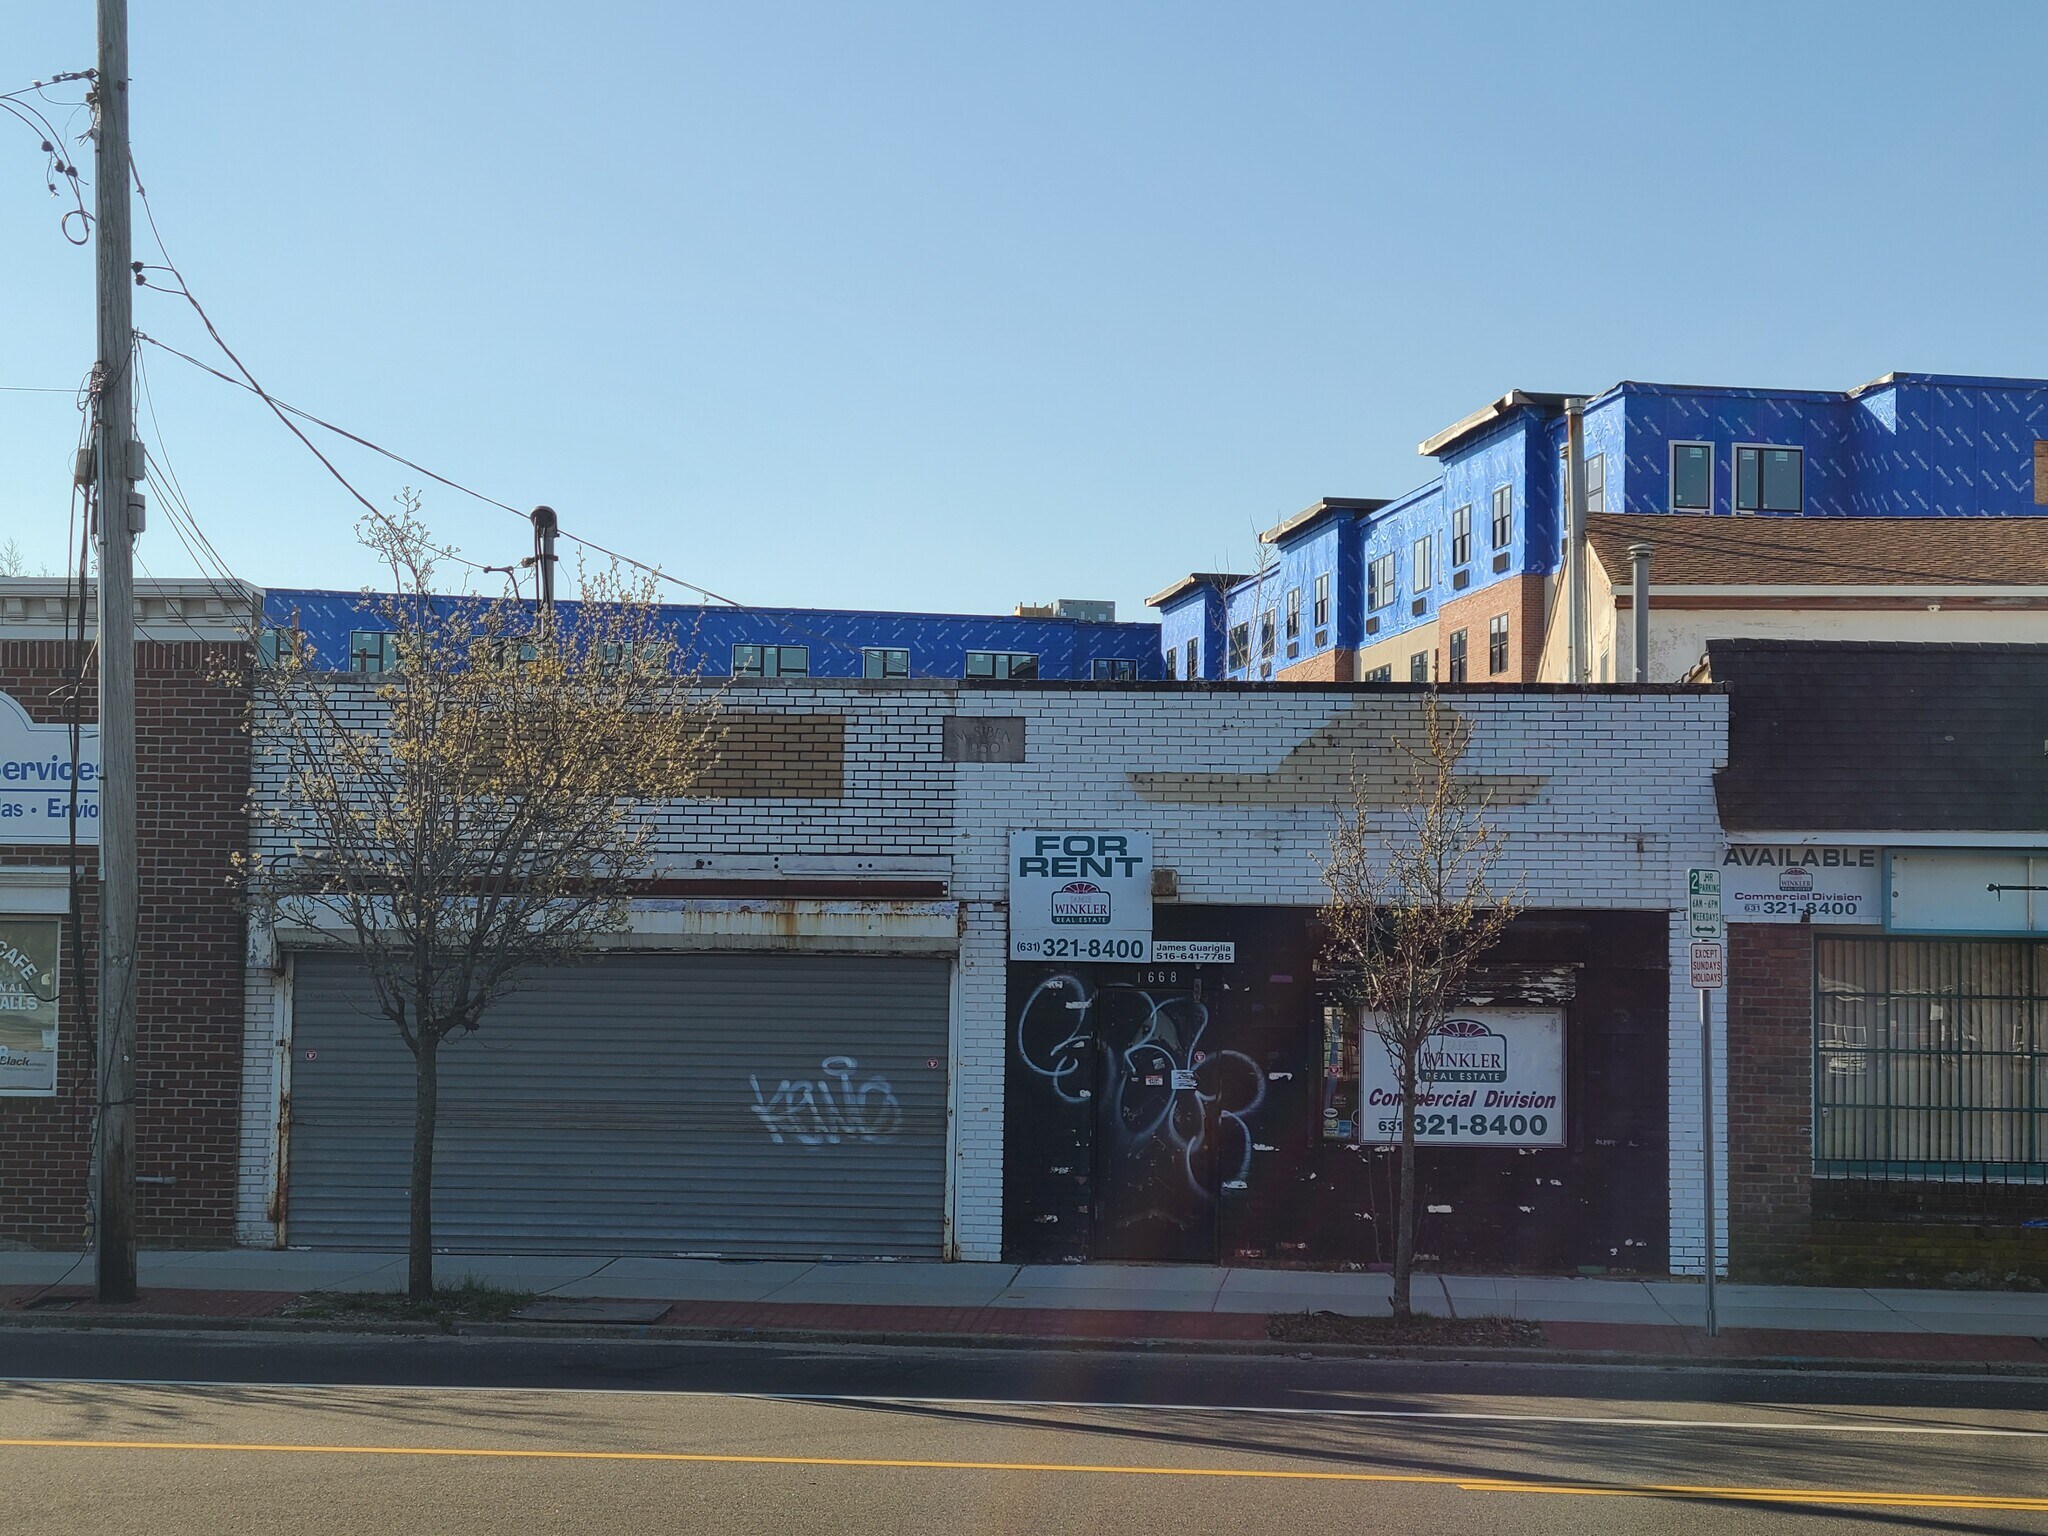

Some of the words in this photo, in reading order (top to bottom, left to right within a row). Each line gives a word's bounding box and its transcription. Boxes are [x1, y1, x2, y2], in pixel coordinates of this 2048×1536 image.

[0, 754, 98, 780] ervice
[0, 798, 23, 817] as
[1035, 835, 1128, 856] FOR
[1722, 849, 1875, 867] AVAILABLE
[1019, 856, 1143, 878] RENT
[1691, 872, 1699, 890] 2
[1700, 884, 1720, 892] PARKING
[1734, 891, 1810, 901] Commercial
[1812, 892, 1862, 901] Division
[1054, 903, 1108, 915] WINKLER
[1763, 902, 1857, 915] 321-8400
[1693, 913, 1718, 921] WEEKDAYS
[1016, 941, 1041, 953] (631)
[1042, 938, 1143, 959] 321-8400
[1156, 943, 1187, 951] James
[1189, 943, 1231, 953] Guariglia
[1695, 949, 1717, 958] EXCEPT
[1156, 953, 1232, 961] 516-641-7785
[1693, 961, 1721, 970] SUNDAYS
[1693, 973, 1721, 982] HOLIDAYS
[1423, 1052, 1501, 1069] WINKLER
[1426, 1072, 1454, 1081] REAL
[1460, 1072, 1500, 1081] ESTATE
[1484, 1090, 1556, 1109] Division
[1378, 1120, 1403, 1132] 631
[1414, 1114, 1548, 1136] 321-8400
